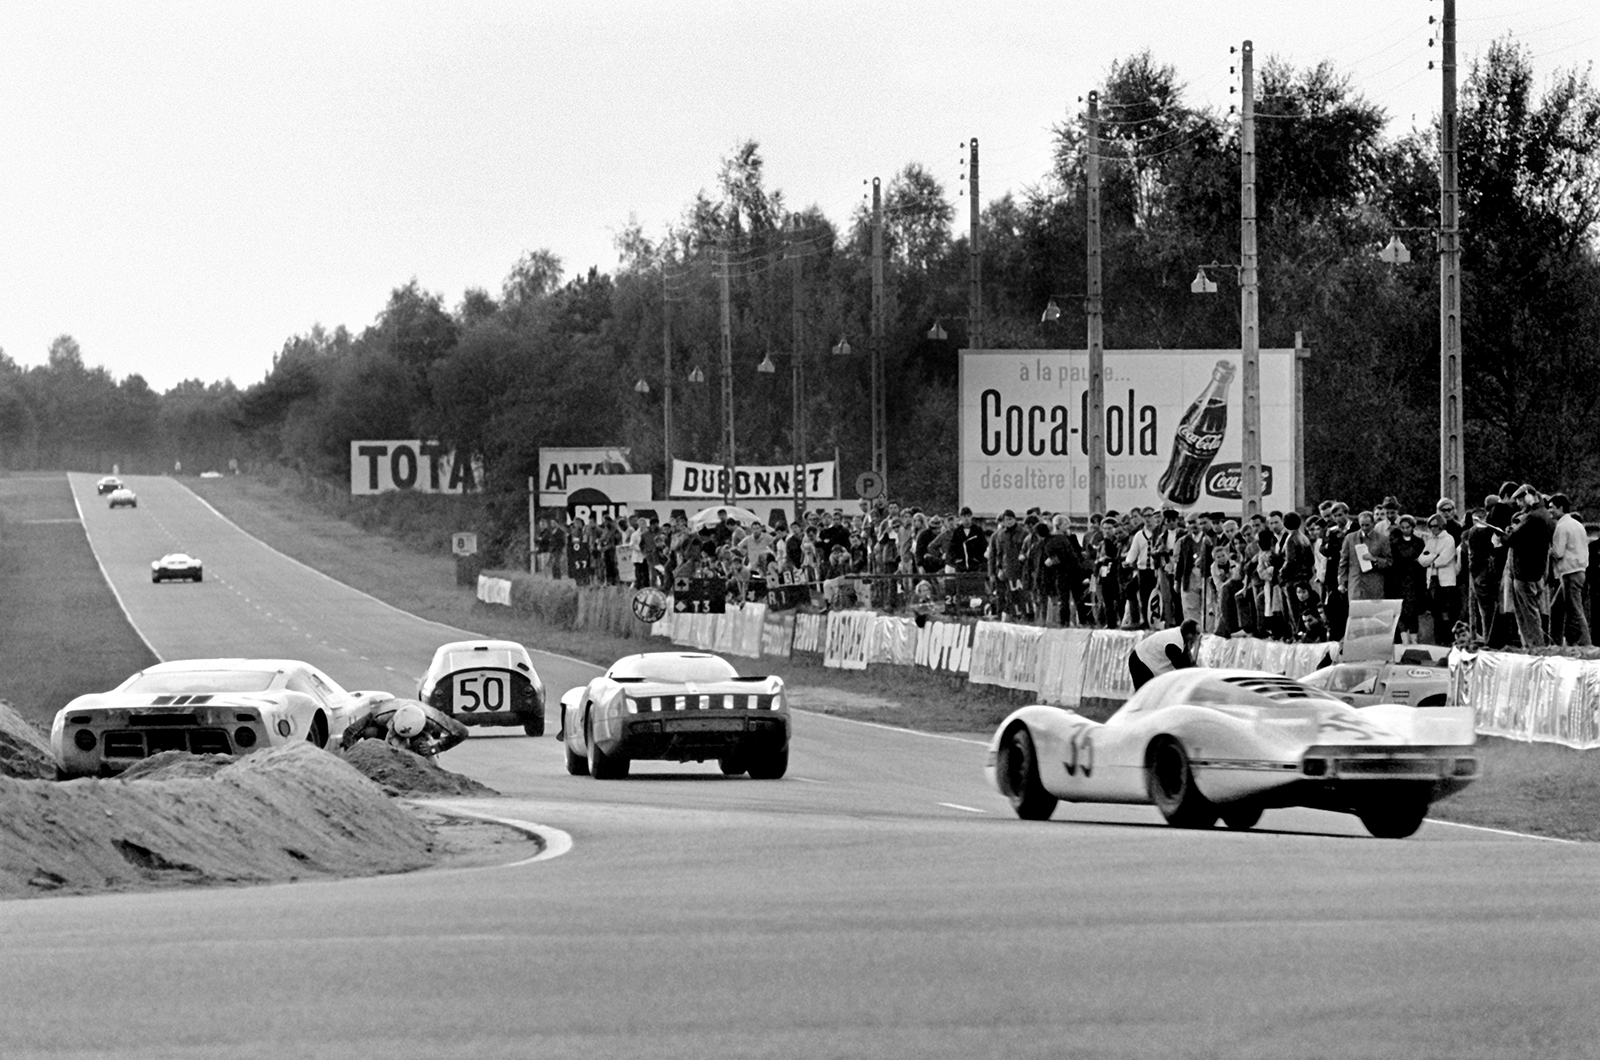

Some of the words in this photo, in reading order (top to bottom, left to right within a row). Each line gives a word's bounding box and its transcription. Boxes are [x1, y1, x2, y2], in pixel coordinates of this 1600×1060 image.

[1019, 361, 1029, 381] à
[1037, 358, 1051, 381] la
[1059, 366, 1131, 389] paue...
[683, 466, 825, 495] DUBONNT
[863, 478, 875, 493] P
[981, 466, 1066, 489] désaltère
[1073, 466, 1088, 489] le
[1105, 468, 1149, 489] ieux
[460, 677, 504, 712] 50
